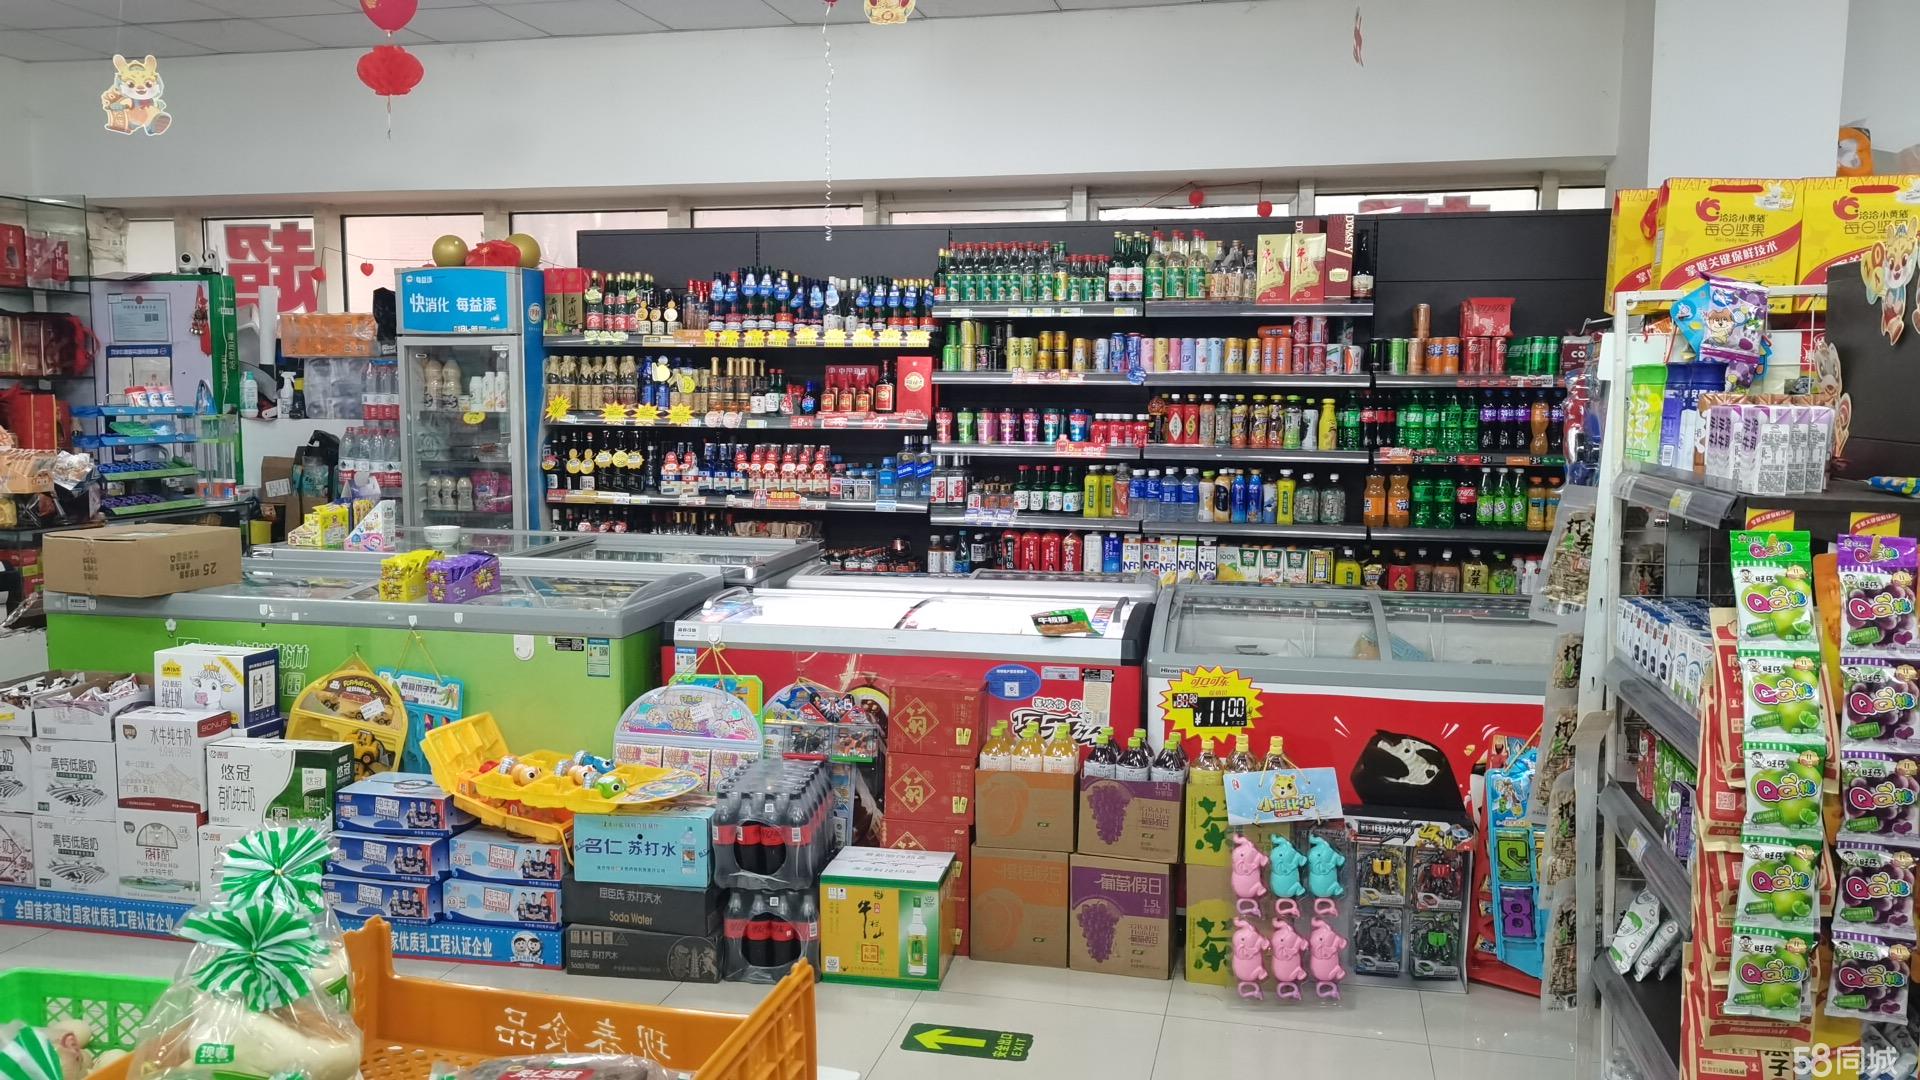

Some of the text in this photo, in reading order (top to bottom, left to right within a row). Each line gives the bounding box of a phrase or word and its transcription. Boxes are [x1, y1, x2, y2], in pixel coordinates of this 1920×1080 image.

[1704, 223, 1765, 237] 每日坚果
[1684, 240, 1778, 277] 掌握关键保鲜技术
[409, 292, 497, 313] 快消化 每益添
[1123, 561, 1139, 570] NFC
[1143, 561, 1159, 570] NFC
[1159, 562, 1176, 572] NFC
[1179, 560, 1196, 571] NFC
[1198, 561, 1216, 571] NFC
[1190, 676, 1230, 688] 可口可乐
[150, 725, 191, 746] 水牛纯牛奶
[50, 757, 97, 773] 高钙低脂奶
[221, 763, 251, 782] 悠冠
[218, 785, 256, 811] 有机纯牛奶
[52, 833, 99, 850] 高钙低脂奶
[584, 837, 677, 857] 名仁 苏打水
[1094, 873, 1161, 896] 葡萄假日
[599, 887, 663, 905] 屈臣氏 苏打汽水
[1143, 899, 1161, 909] 1.5L
[15, 899, 174, 933] 全国首家通过国家优质乳工程认证企业
[609, 910, 653, 926] Soda Water
[199, 1043, 229, 1059] 现春
[1010, 1038, 1027, 1057] EXIT
